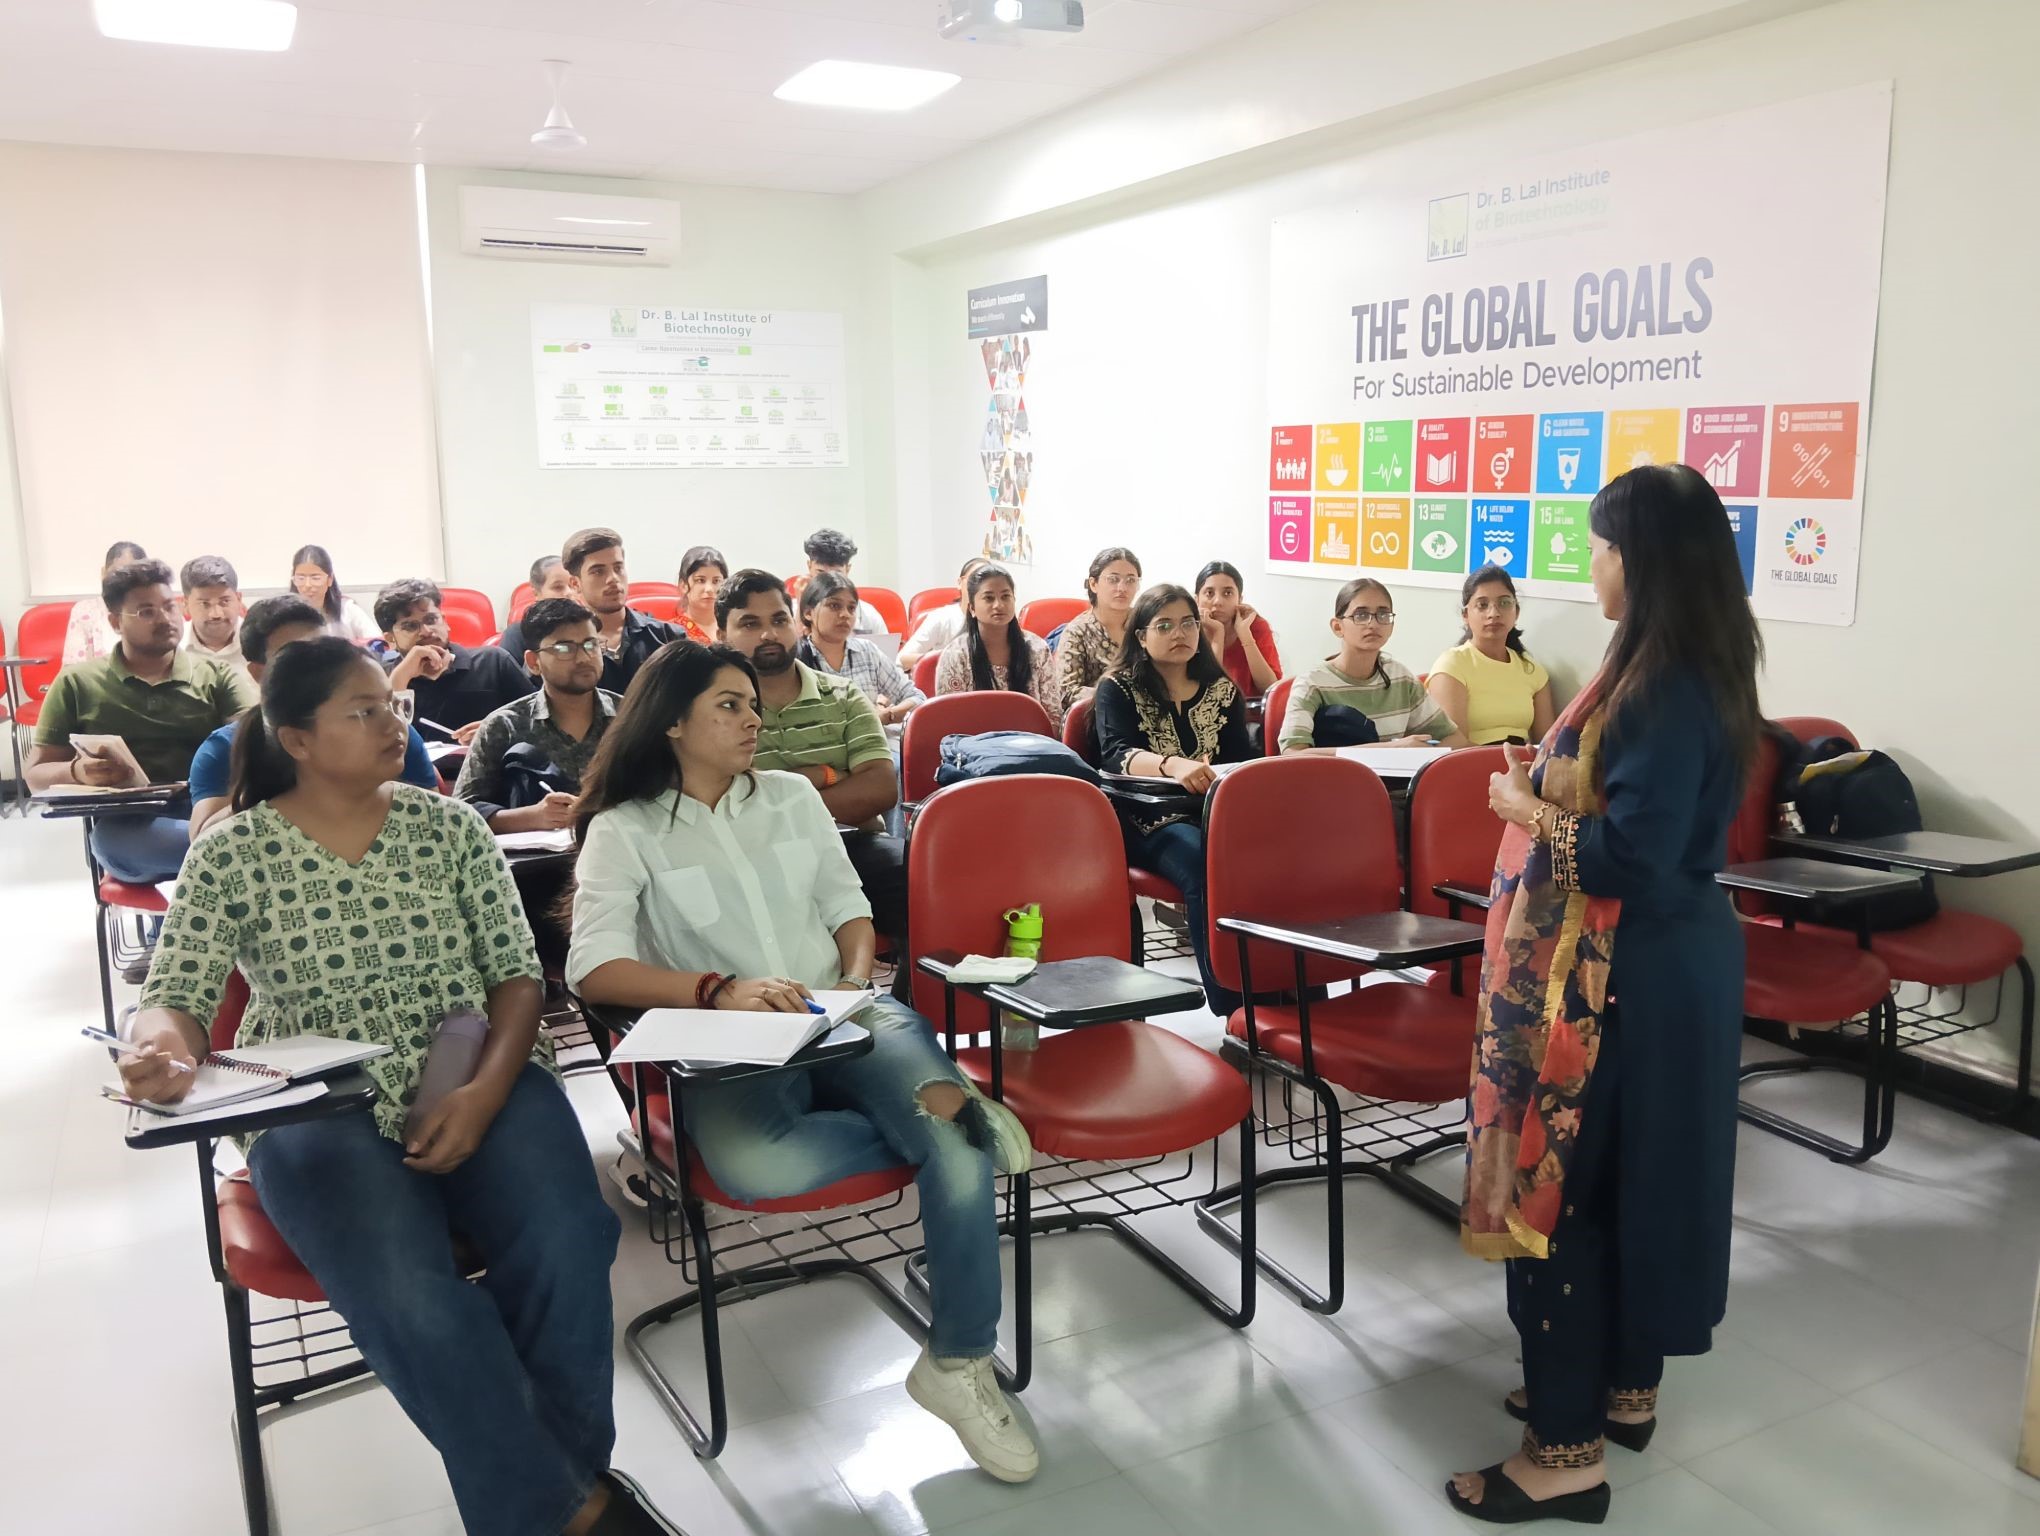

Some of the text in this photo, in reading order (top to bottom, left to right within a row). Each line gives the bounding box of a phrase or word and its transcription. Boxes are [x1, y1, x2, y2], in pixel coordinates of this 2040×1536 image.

[1477, 170, 1611, 209] Dr. B. Lal Institute
[1475, 198, 1608, 231] of Biotechnology
[1430, 241, 1440, 257] Dr.
[1452, 235, 1465, 254] Lal
[642, 310, 773, 324] Dr. B. Lal Institute of
[1351, 257, 1714, 364] THE GLOBAL GOALS
[664, 323, 752, 337] Biotechnology
[1353, 350, 1702, 400] For Sustainable Development
[1543, 419, 1552, 437] 6
[1692, 413, 1702, 434] 8
[1779, 411, 1789, 433] 9
[1320, 429, 1326, 444] 2
[1368, 427, 1374, 442] 3
[1420, 424, 1428, 440] 4
[1479, 422, 1486, 439] 5
[1275, 432, 1279, 446] 1
[1273, 501, 1281, 516] 10
[1317, 502, 1324, 517] 11
[1367, 503, 1376, 519] 12
[1418, 504, 1429, 520] 13
[1476, 505, 1488, 522] 14
[1540, 507, 1552, 525] 15
[1771, 569, 1838, 584] THE GLOBAL GOALS
